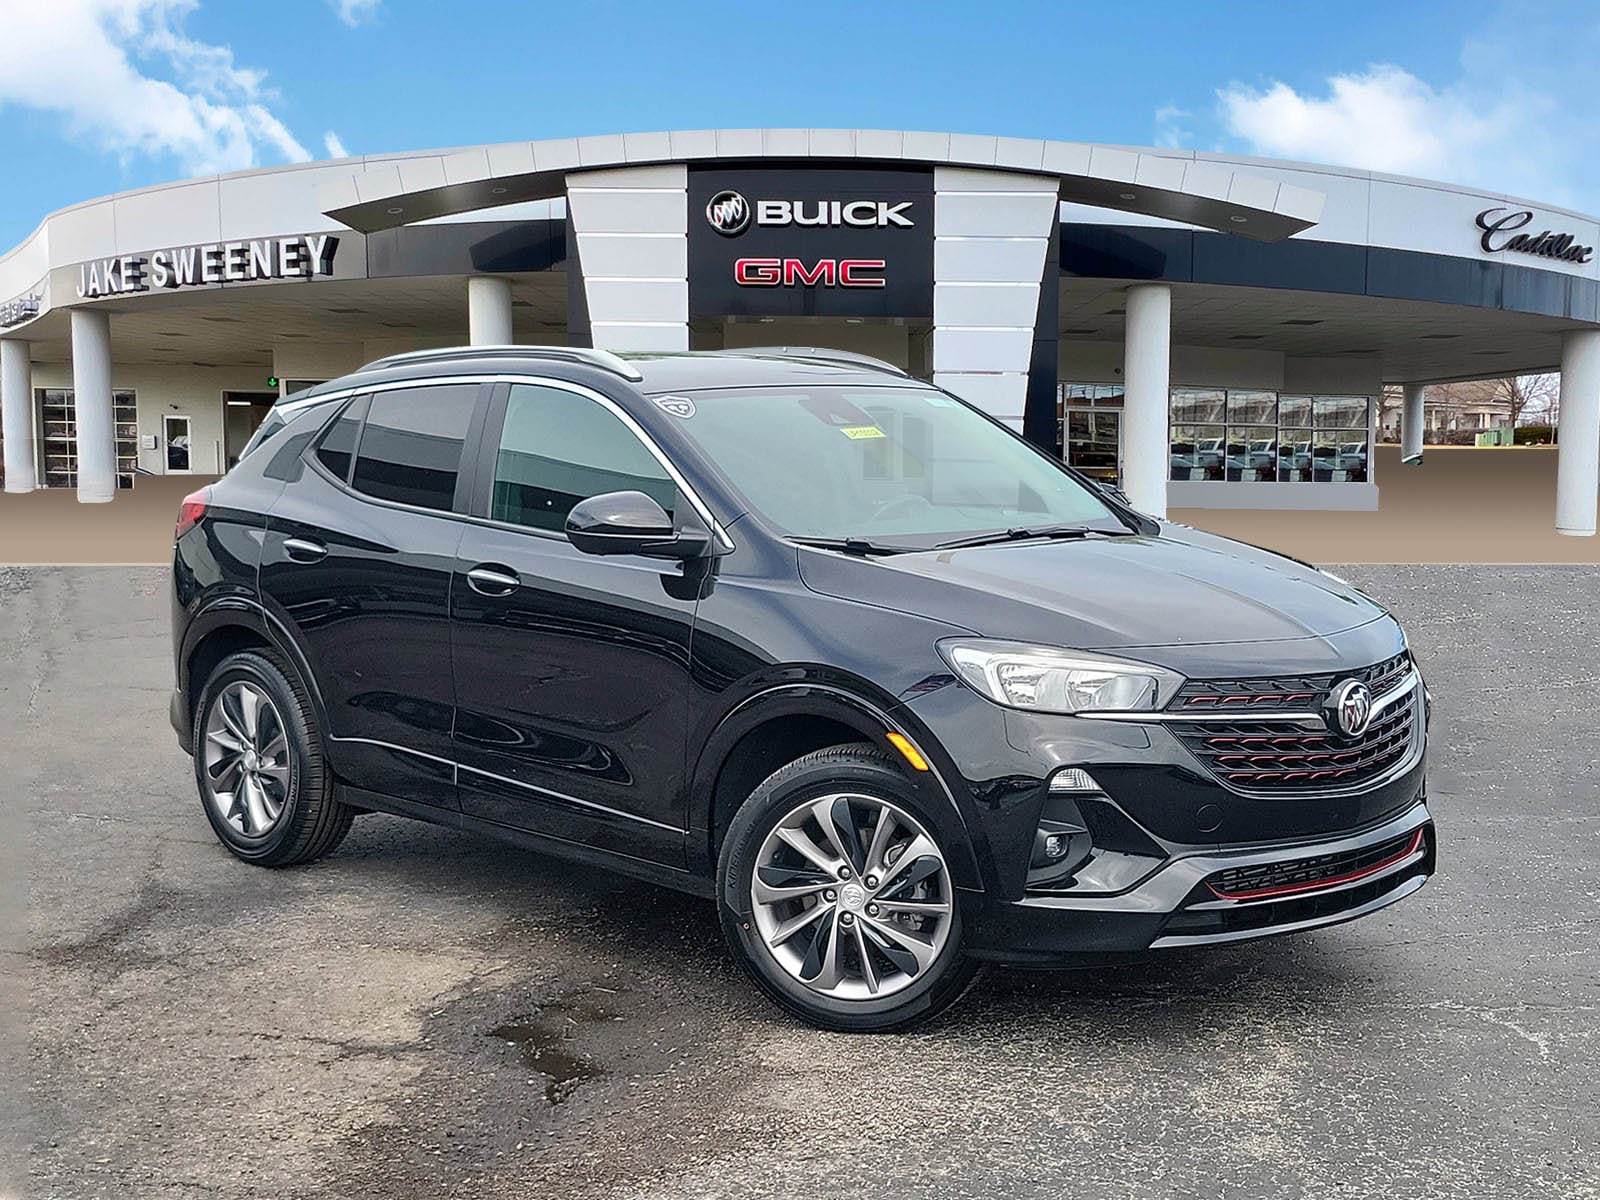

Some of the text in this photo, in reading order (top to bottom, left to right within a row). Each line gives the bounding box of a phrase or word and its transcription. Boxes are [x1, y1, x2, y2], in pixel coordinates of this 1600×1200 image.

[757, 201, 914, 226] BUICK
[1475, 207, 1593, 263] Cadillac
[76, 235, 337, 298] JAKE SWEENEY
[734, 258, 886, 287] GMC
